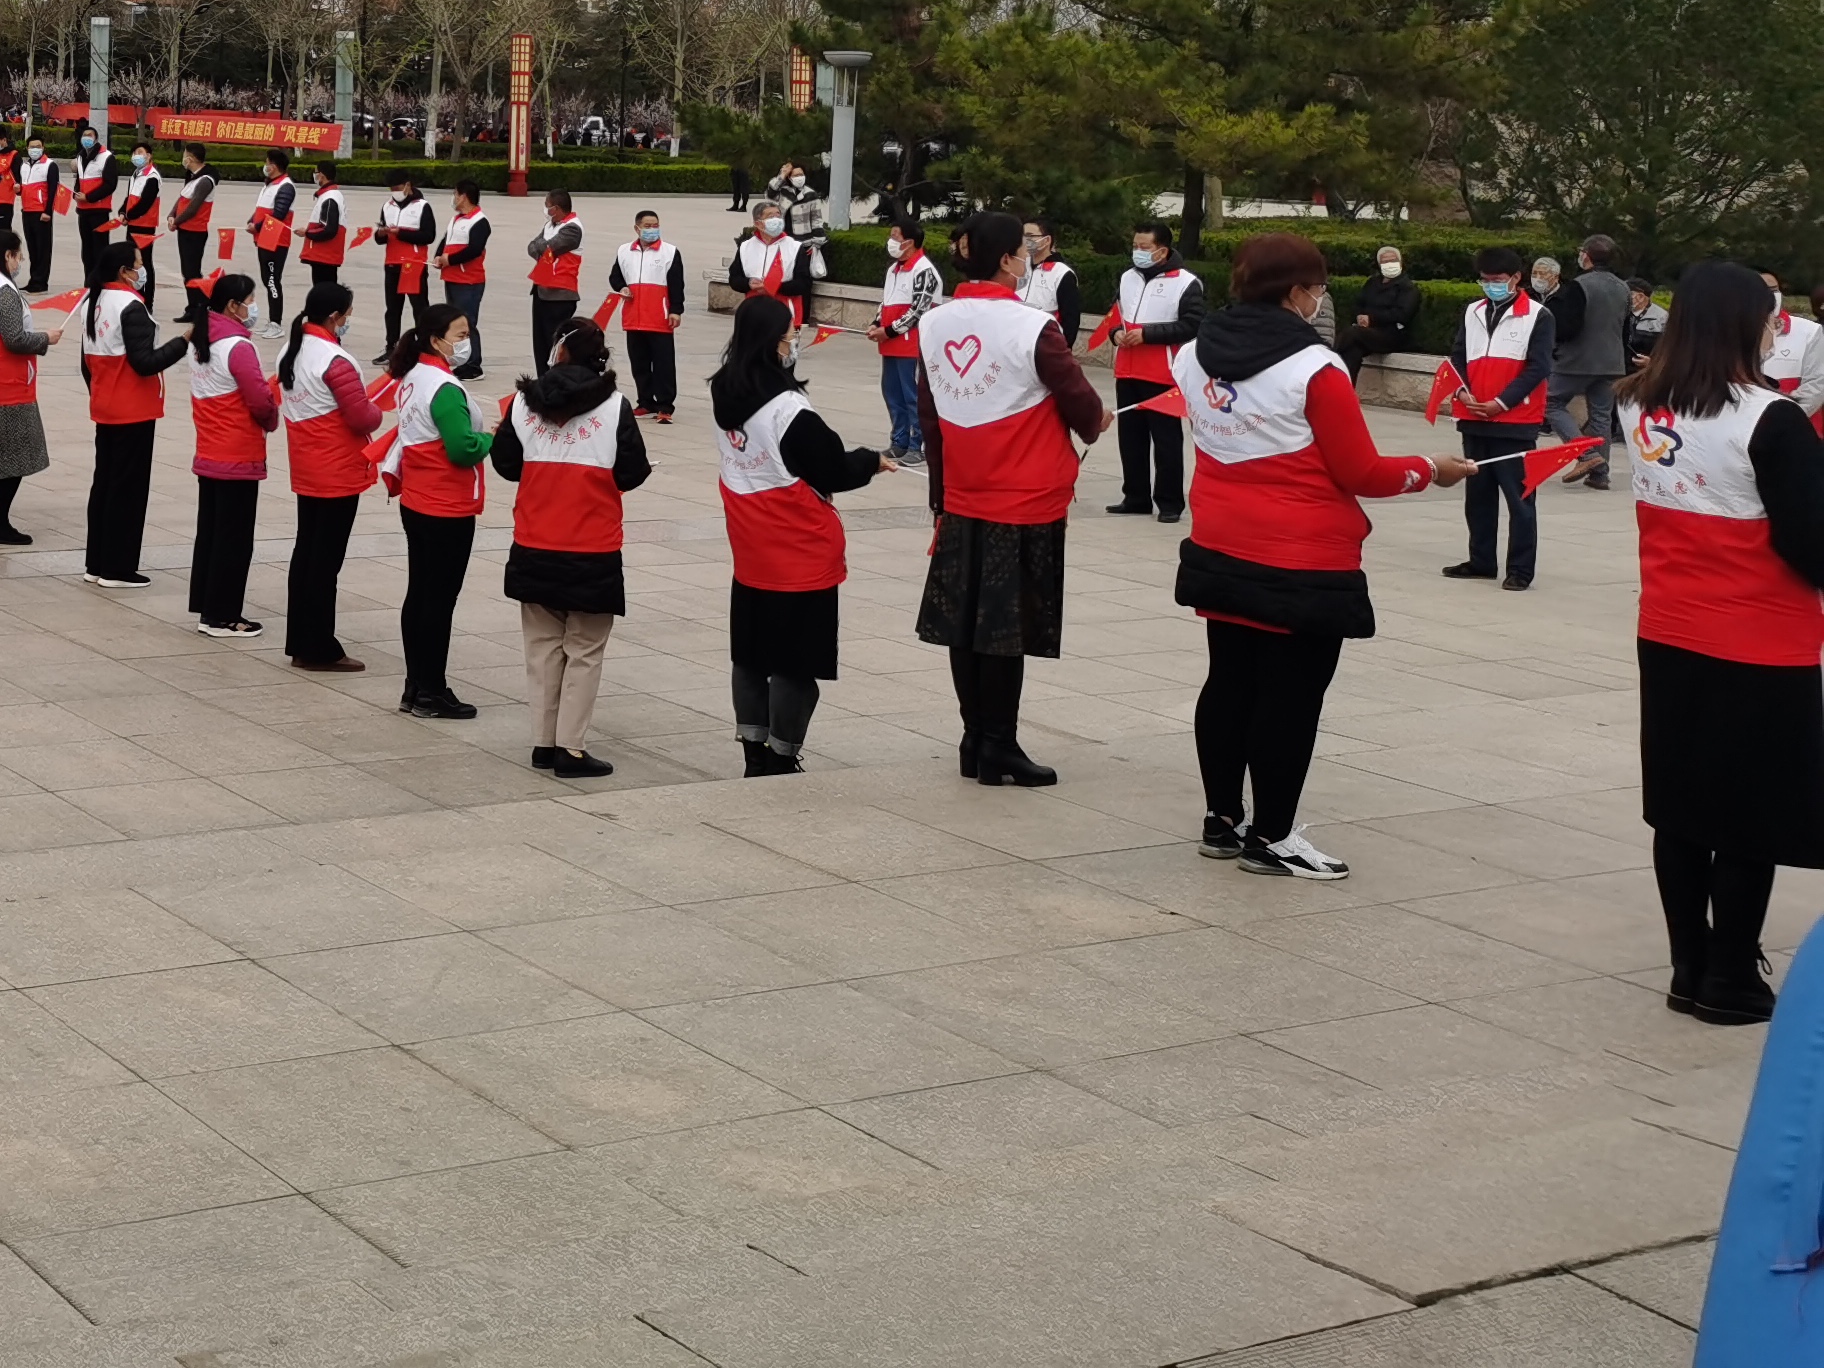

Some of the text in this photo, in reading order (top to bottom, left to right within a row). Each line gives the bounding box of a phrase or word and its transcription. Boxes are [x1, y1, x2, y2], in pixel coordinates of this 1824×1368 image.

[216, 121, 275, 142] 你们是靓丽的
[523, 413, 603, 445] 青州市志愿者
